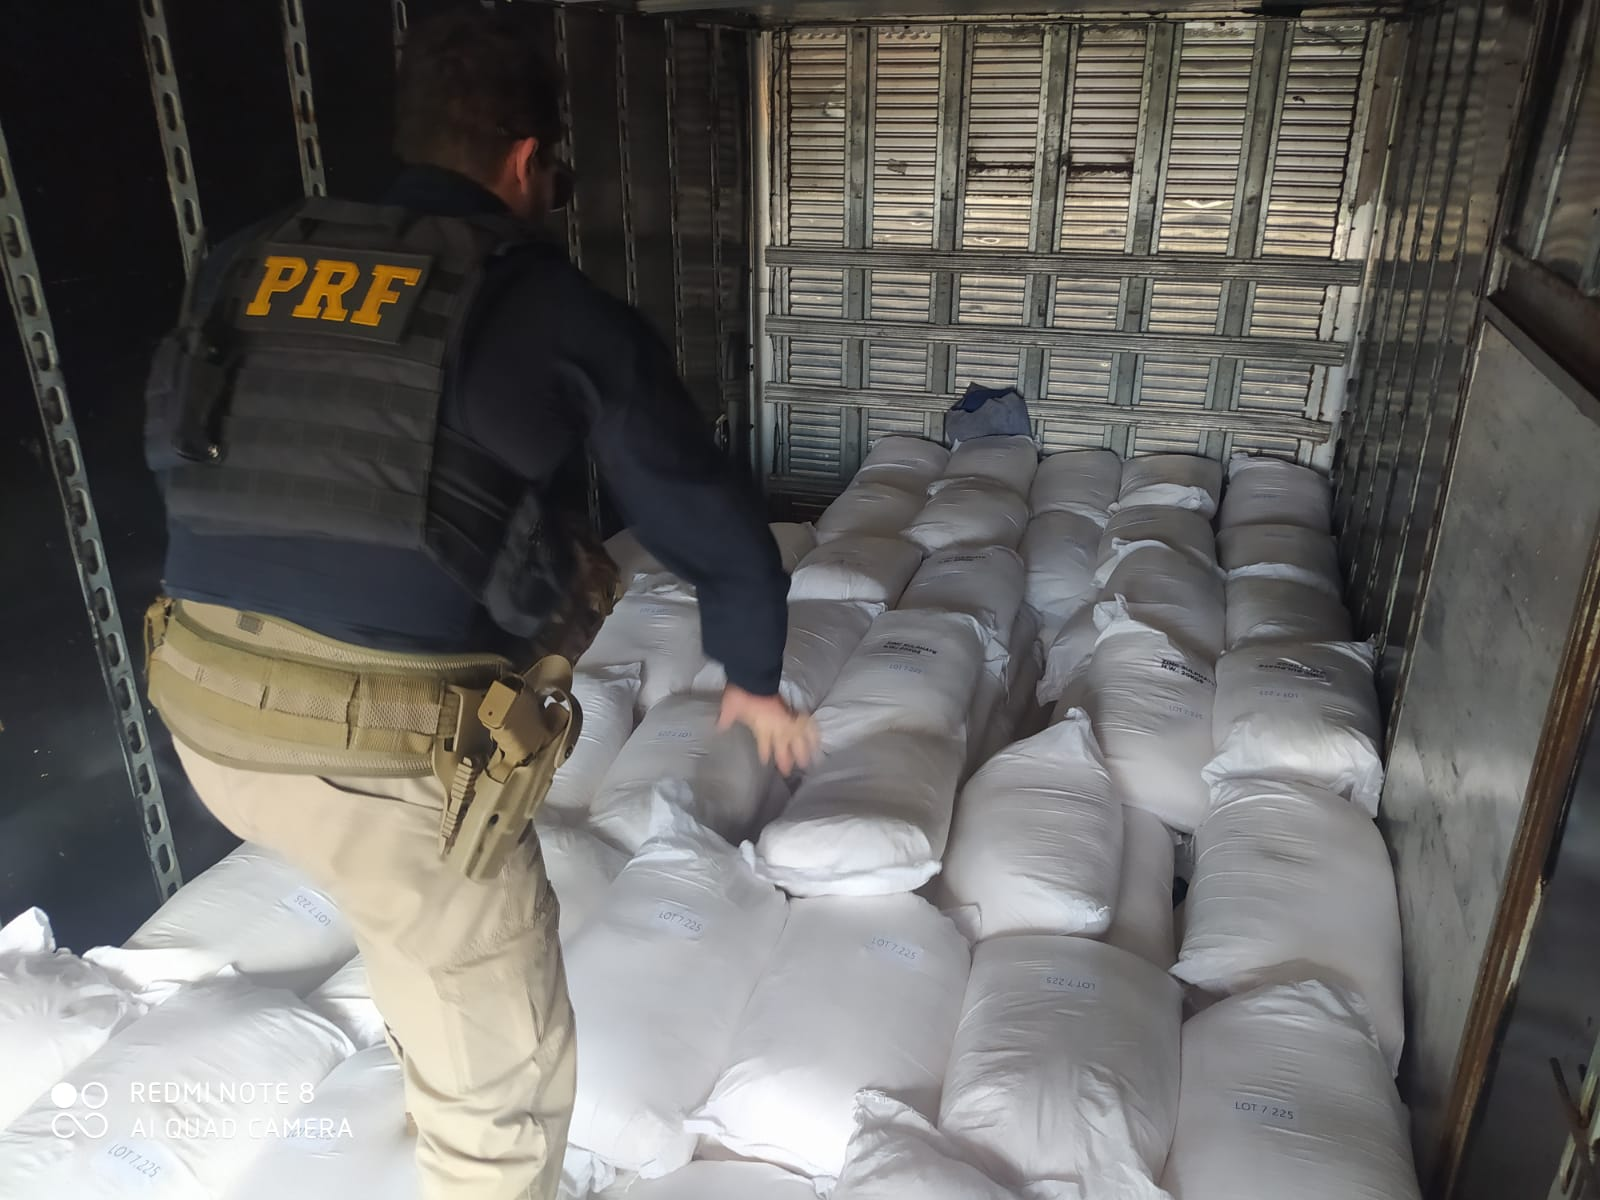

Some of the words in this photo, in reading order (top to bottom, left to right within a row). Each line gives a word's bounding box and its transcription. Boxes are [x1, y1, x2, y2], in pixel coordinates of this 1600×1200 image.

[245, 255, 422, 327] PRF
[1161, 658, 1180, 668] ZINC
[314, 911, 331, 927] LOT
[659, 911, 678, 921] LOT
[872, 937, 892, 948] LOT
[1077, 981, 1095, 990] LOT
[1235, 1101, 1257, 1112] LOT
[107, 1143, 134, 1160] LOT
